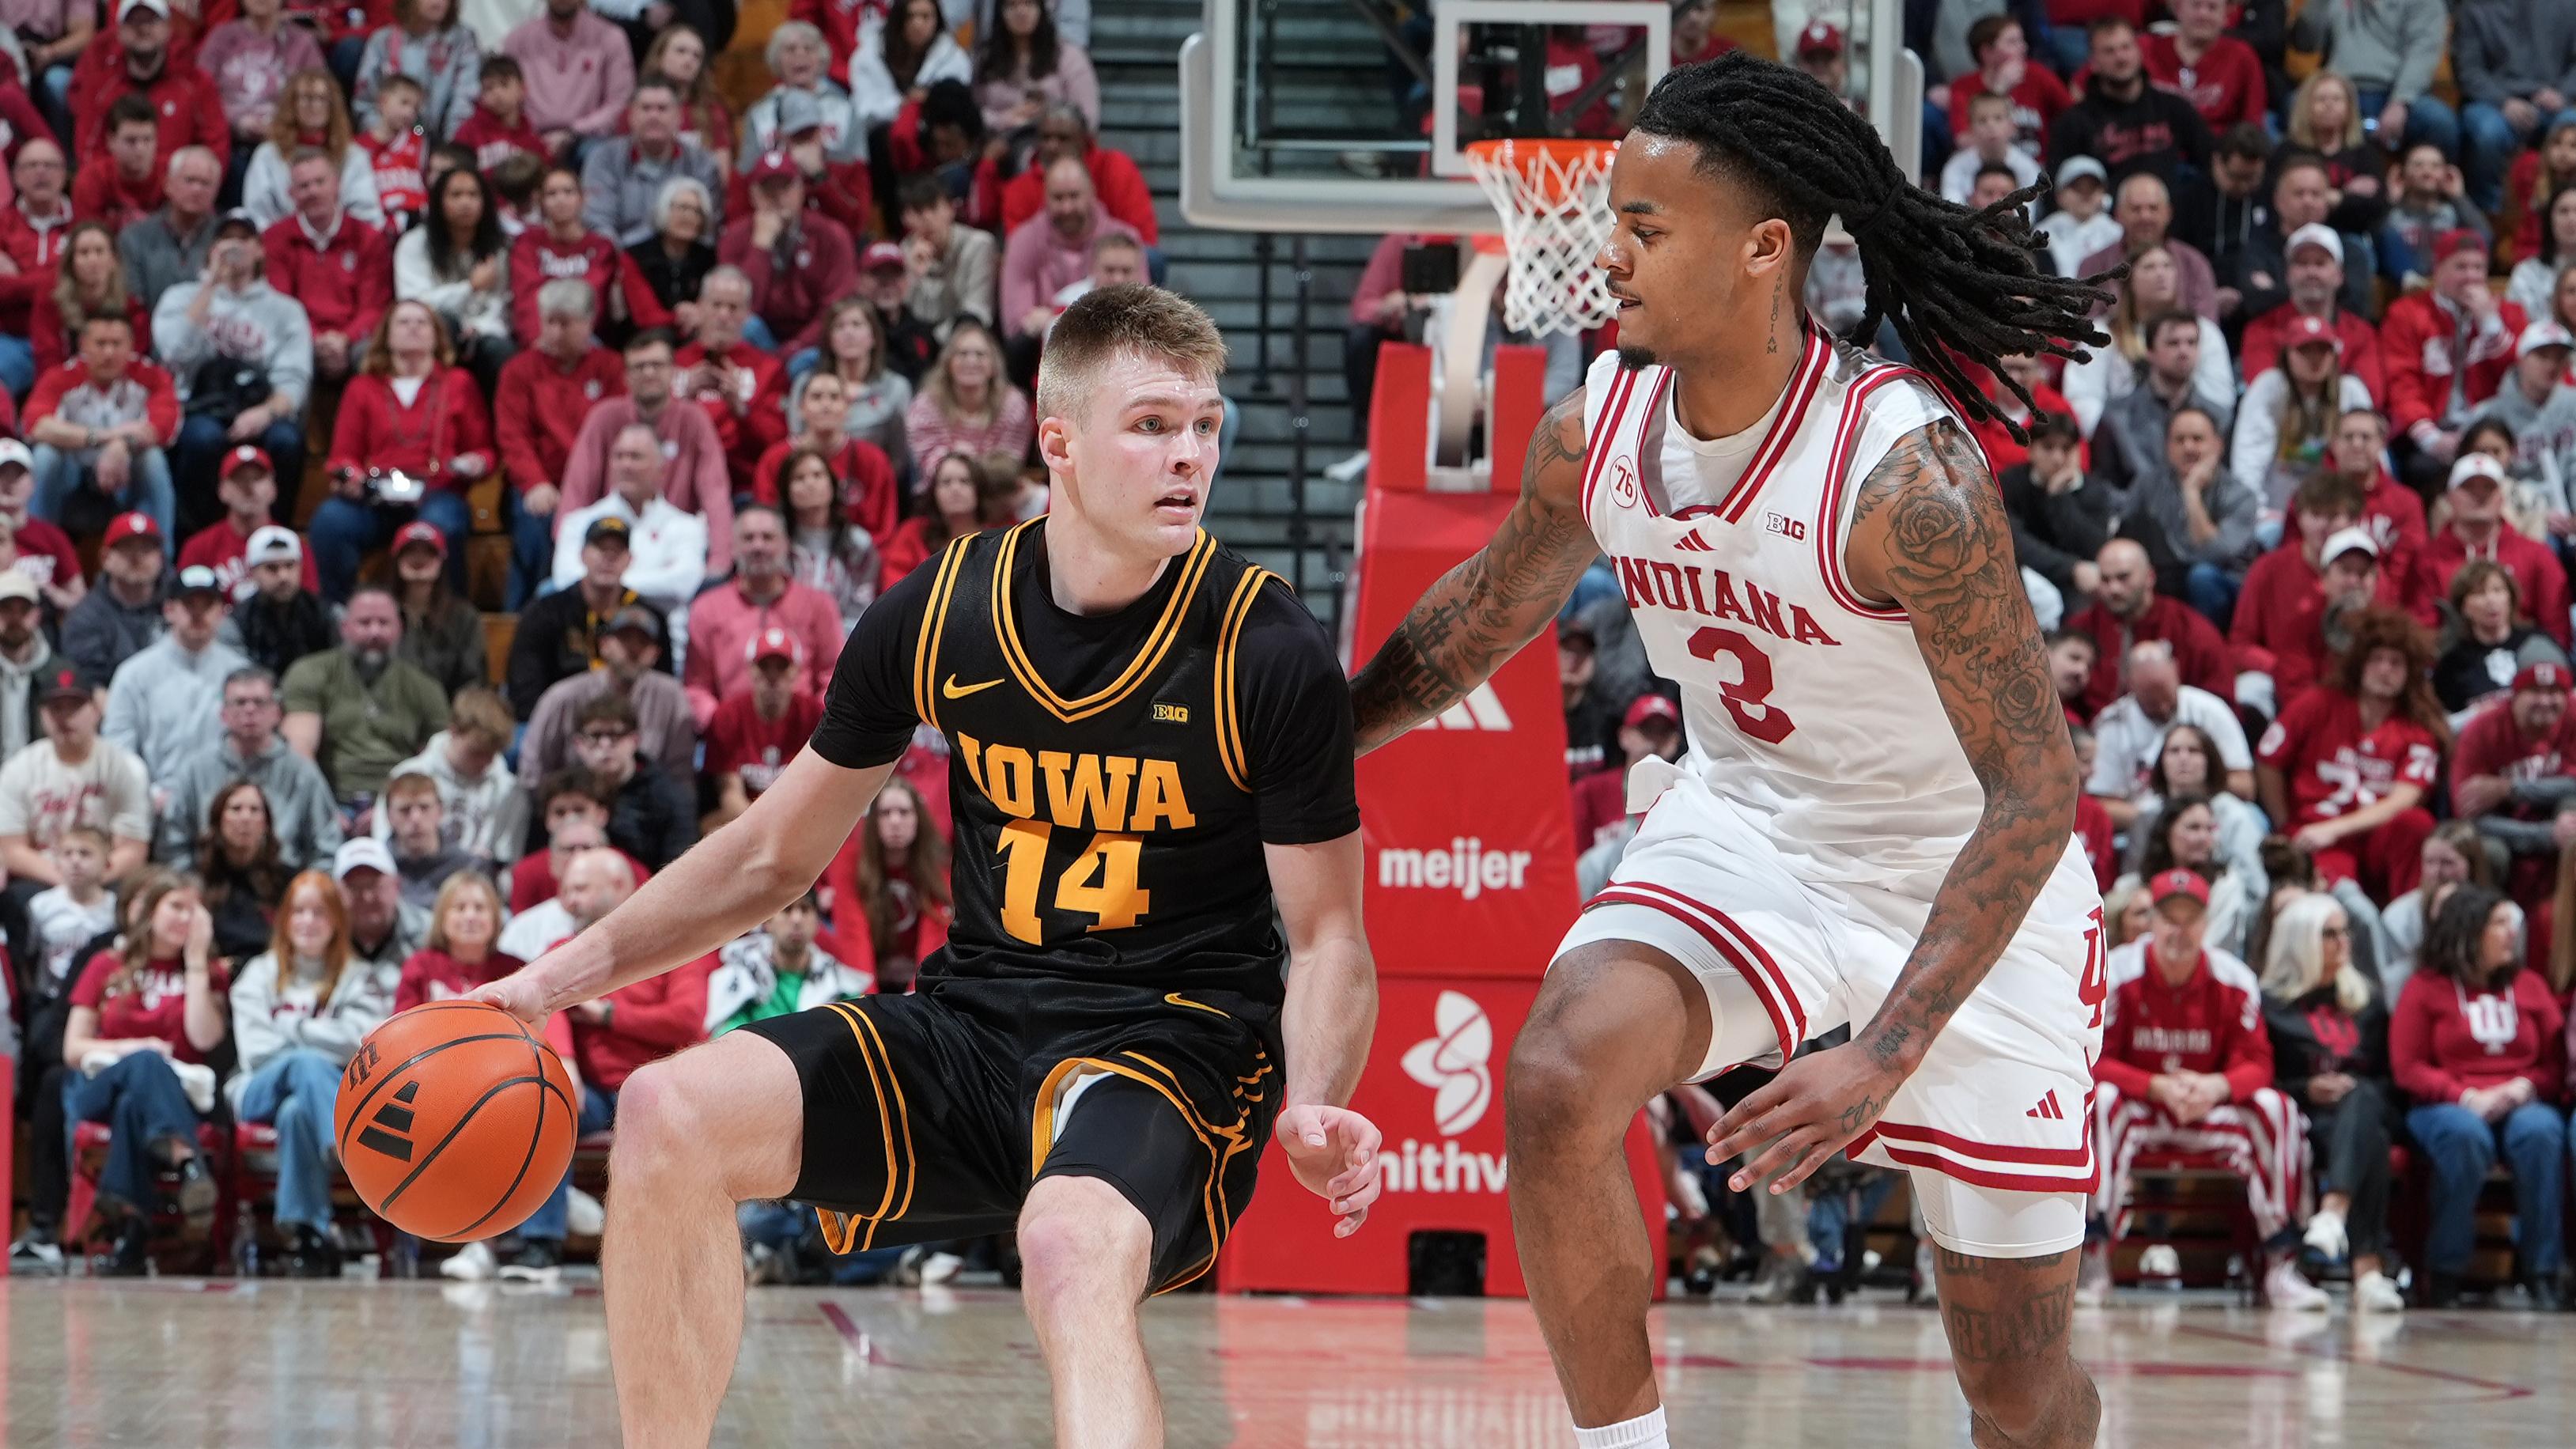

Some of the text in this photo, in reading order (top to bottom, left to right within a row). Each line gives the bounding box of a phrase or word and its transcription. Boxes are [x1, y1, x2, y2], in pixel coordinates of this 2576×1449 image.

[1687, 626, 1795, 745] 3
[957, 731, 1196, 831] IOWA
[997, 819, 1150, 946] 14
[1379, 836, 1532, 900] meijer
